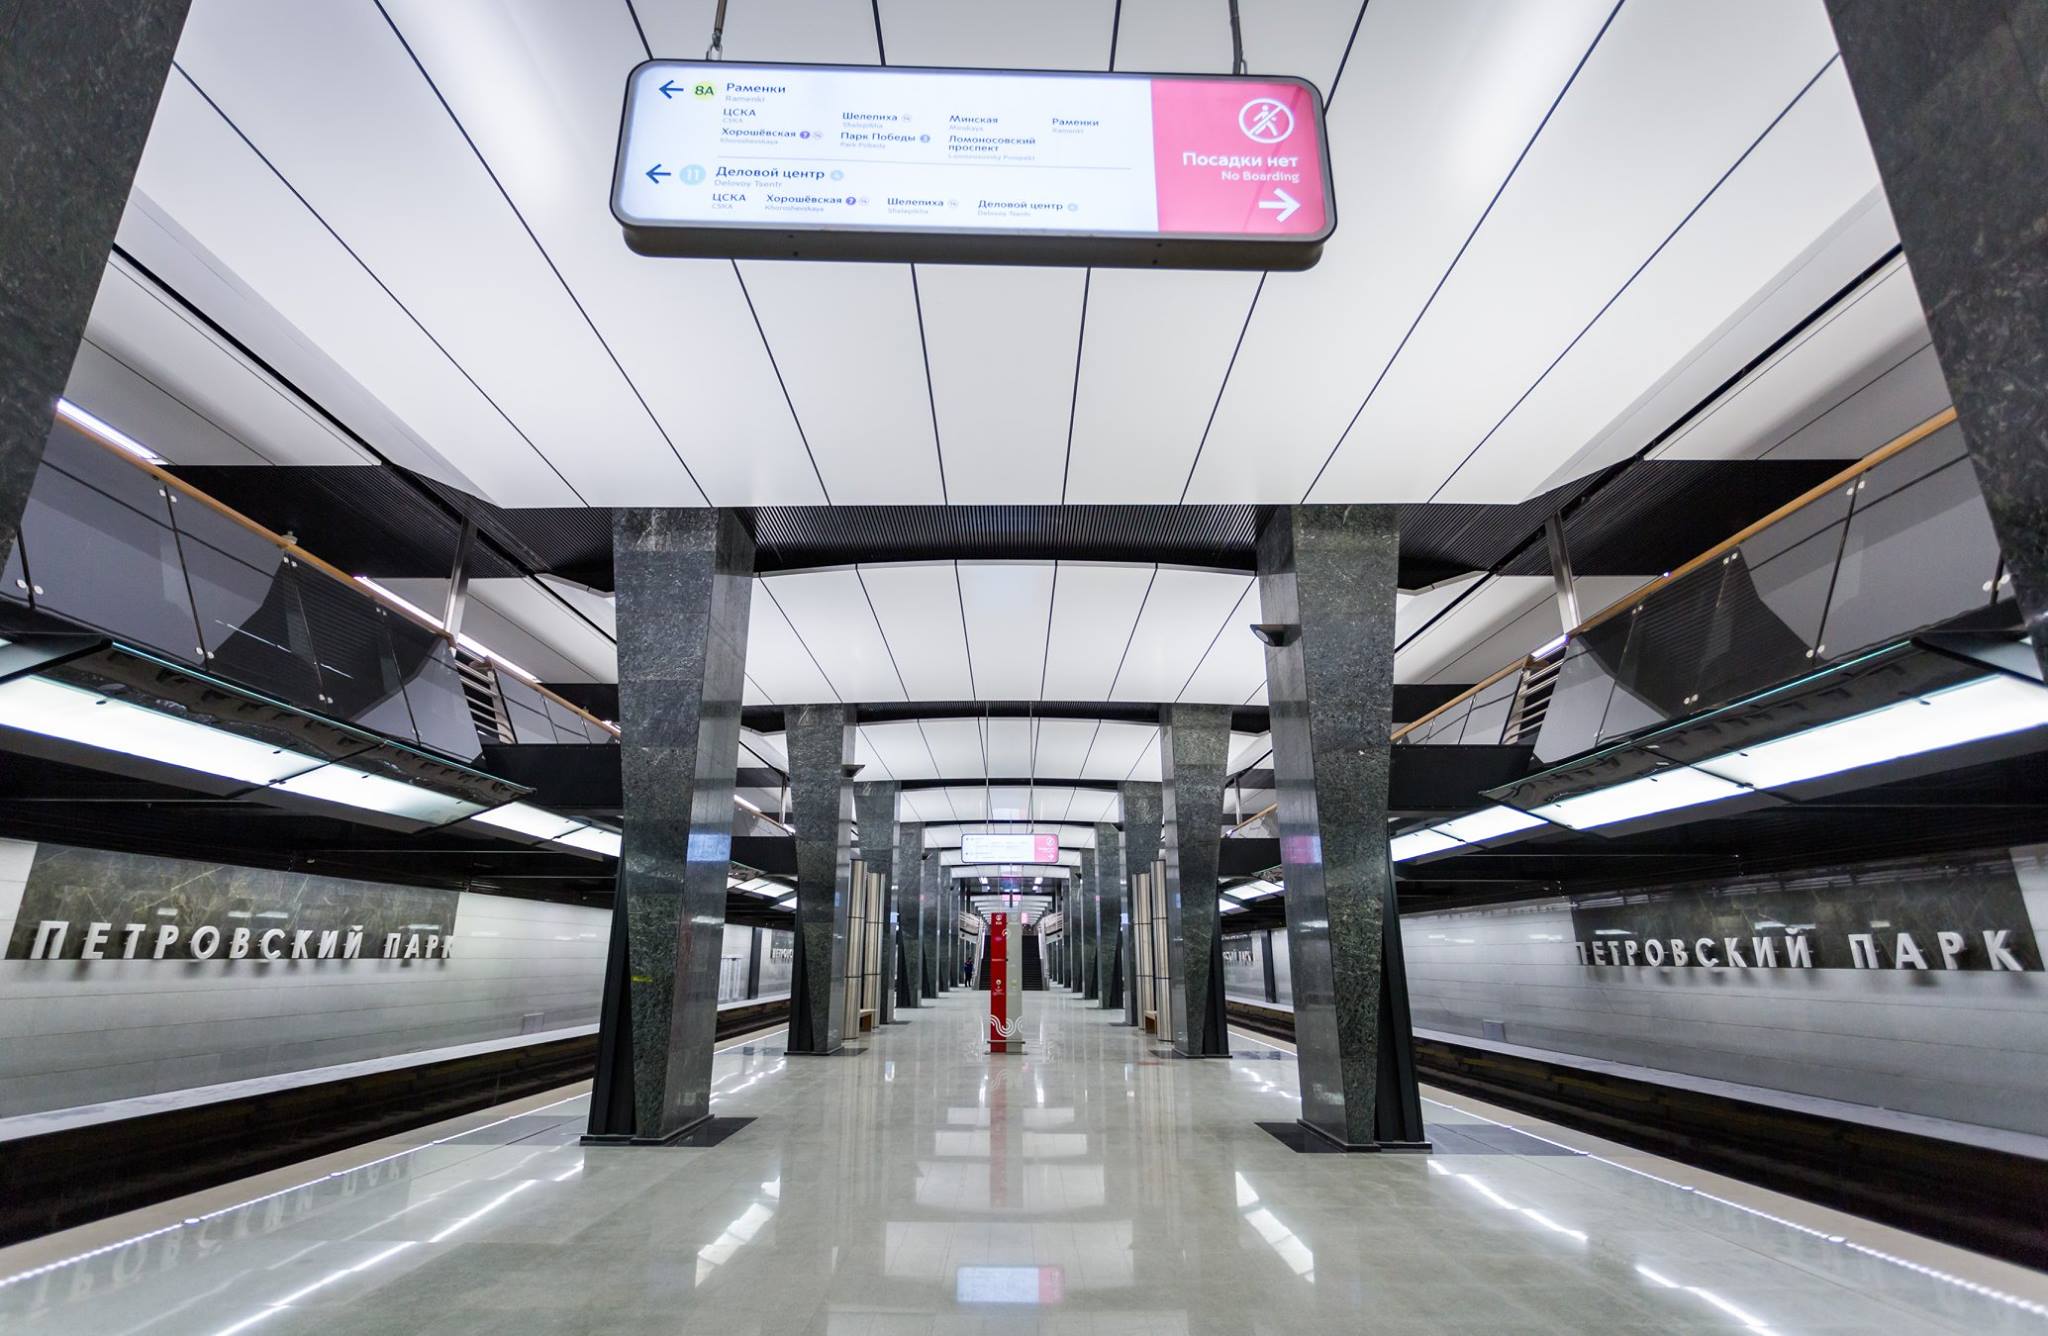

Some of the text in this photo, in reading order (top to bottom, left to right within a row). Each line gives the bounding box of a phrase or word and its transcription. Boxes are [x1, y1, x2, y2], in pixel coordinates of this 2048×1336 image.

[726, 82, 786, 94] Раменки
[723, 108, 757, 118] ЦСКА
[842, 111, 898, 121] Шелепиха
[949, 114, 999, 124] Минская
[1052, 117, 1099, 127] Раменки
[722, 128, 796, 138] Хорошёвская
[840, 131, 868, 142] Парк
[872, 132, 916, 143] Победы
[949, 134, 1036, 145] Ломоносовский
[948, 144, 999, 152] проспект
[1182, 152, 1298, 168] Посадки нет
[715, 166, 779, 179] Деловой
[783, 169, 825, 181] центр
[1221, 170, 1299, 183] No Boarding
[712, 193, 746, 203] ЦСКА
[767, 194, 843, 205] Хорошёвская
[887, 197, 944, 207] Шелепиха
[978, 199, 1064, 212] Деловой центр
[30, 920, 455, 960] ПЕТРОВСКИЙ ПАРК
[1575, 927, 2023, 971] ПЕТРОВСКИЙ ПАРК
